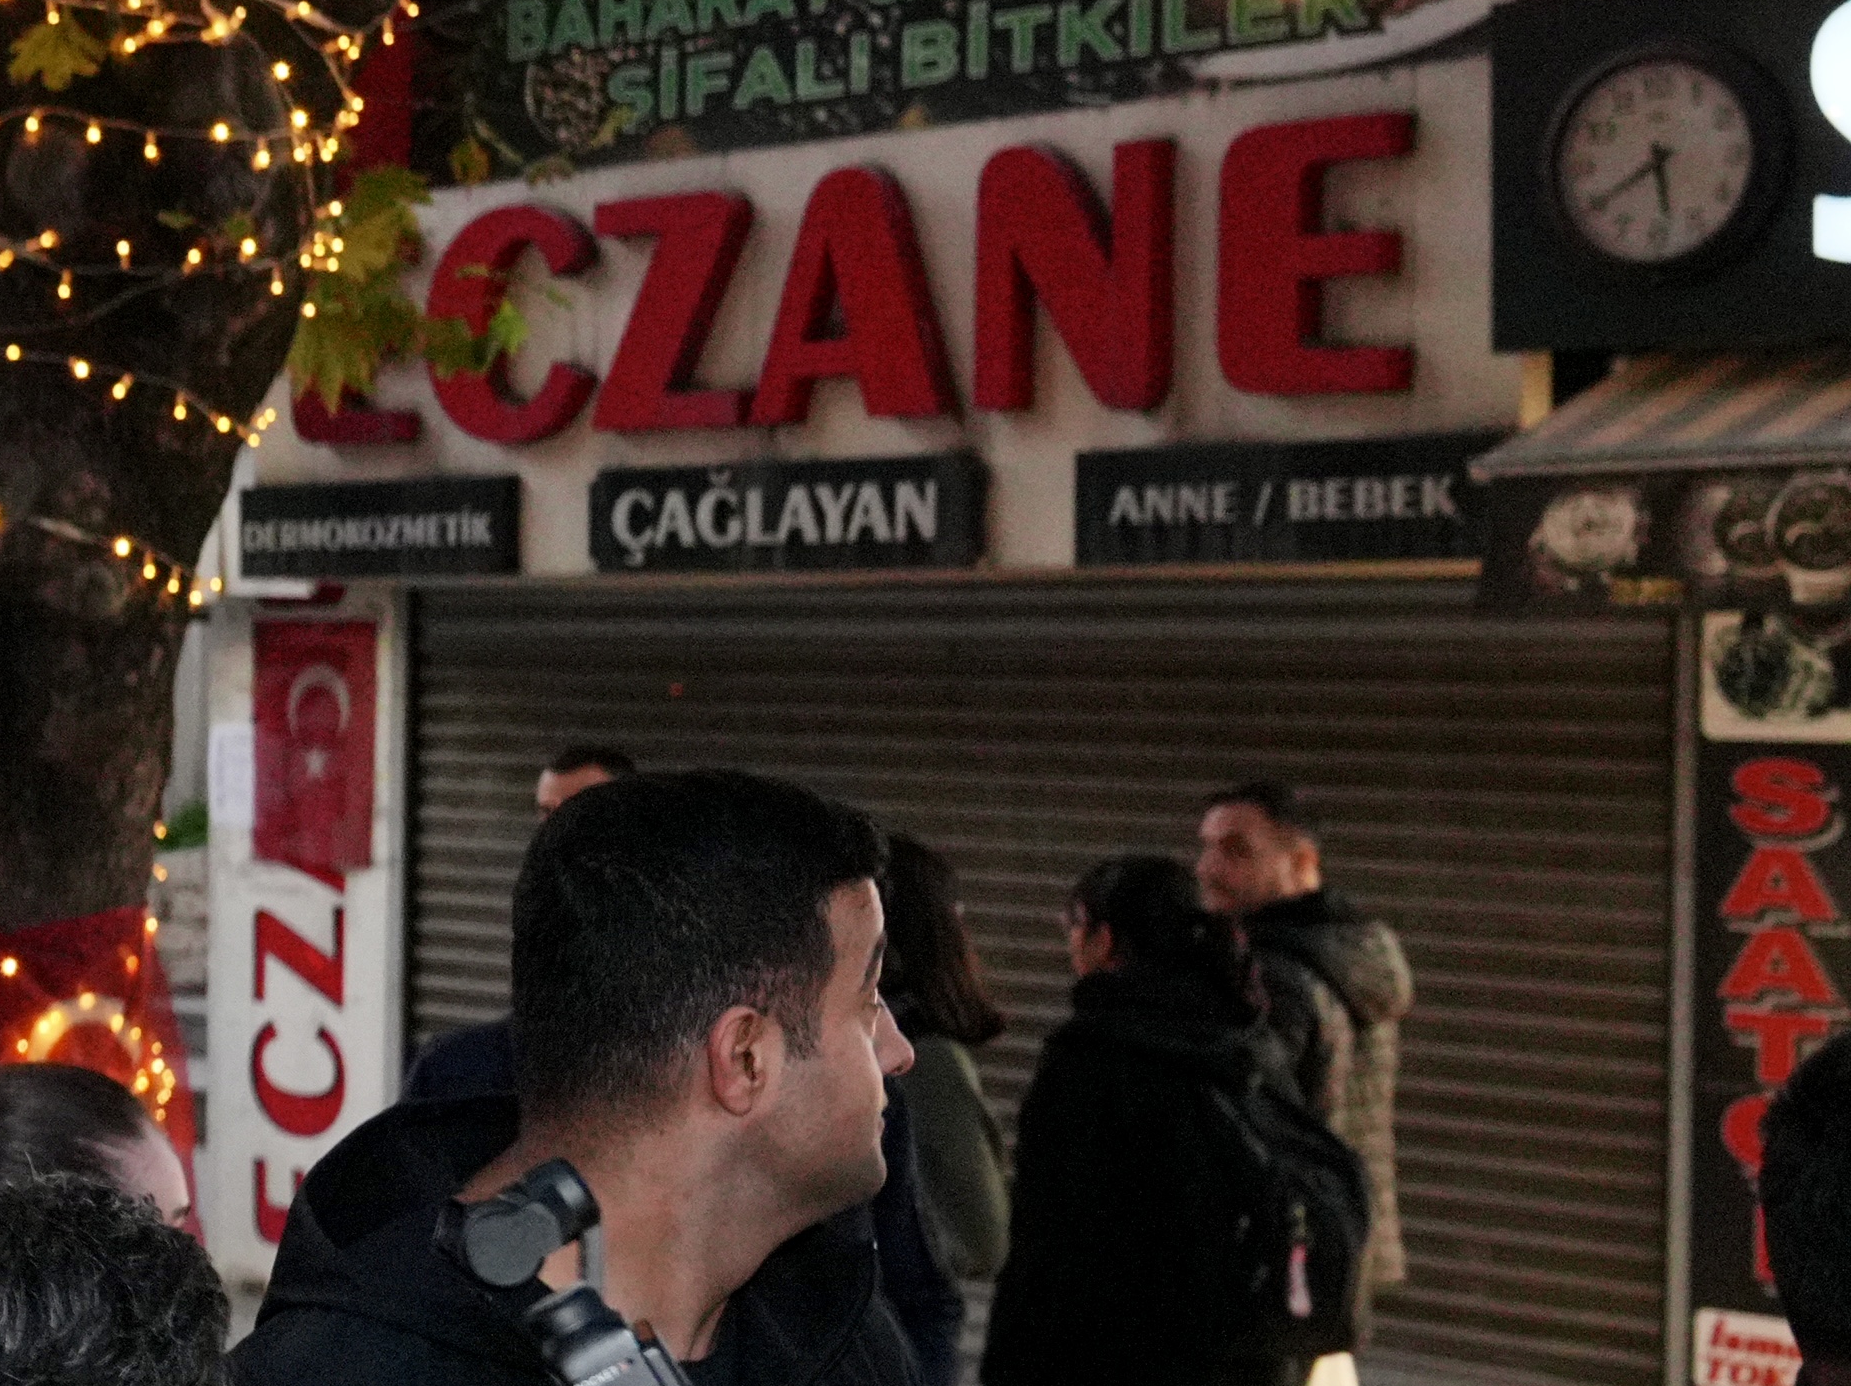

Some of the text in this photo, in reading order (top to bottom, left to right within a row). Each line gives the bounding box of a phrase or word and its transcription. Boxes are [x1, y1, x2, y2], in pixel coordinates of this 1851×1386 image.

[606, 31, 871, 134] ŞİFALI
[610, 469, 938, 566] ÇAĞLAYAN
[1108, 482, 1238, 526] ANNE
[1285, 474, 1461, 522] BEBEK
